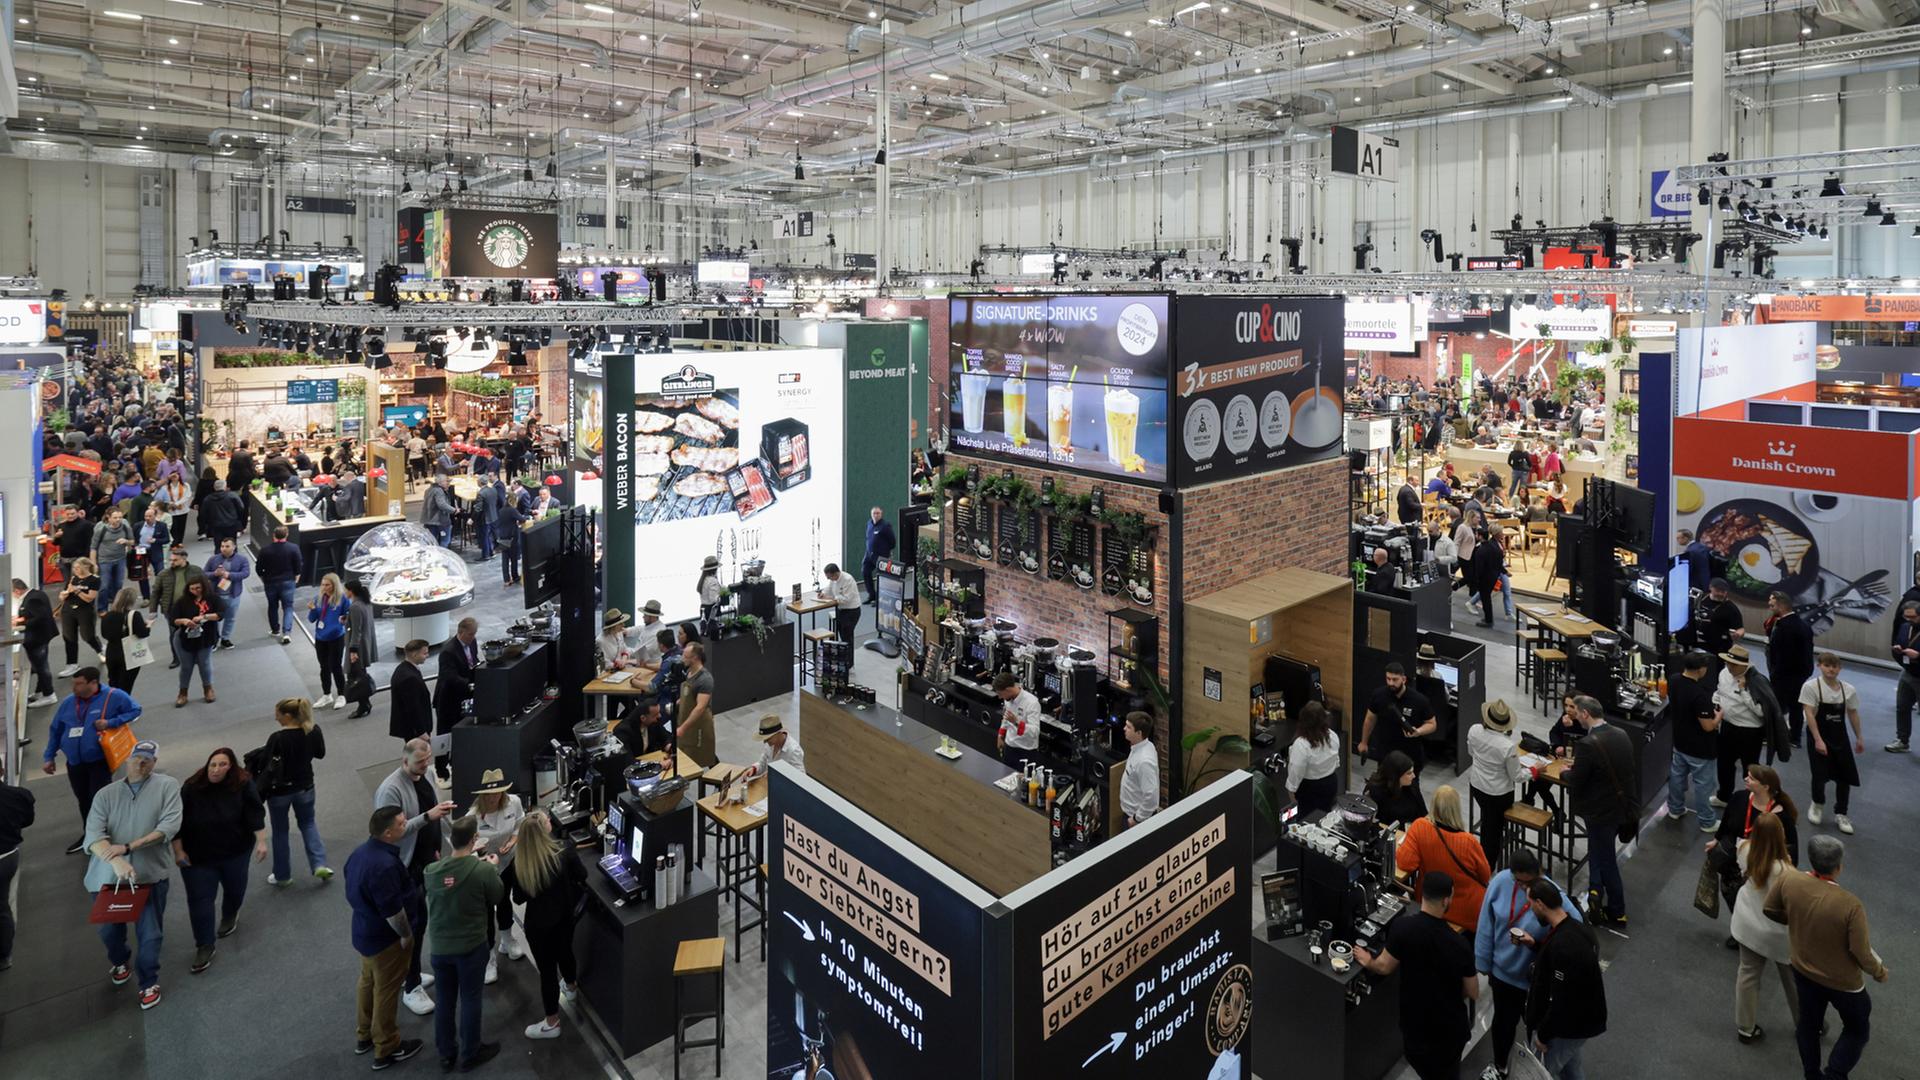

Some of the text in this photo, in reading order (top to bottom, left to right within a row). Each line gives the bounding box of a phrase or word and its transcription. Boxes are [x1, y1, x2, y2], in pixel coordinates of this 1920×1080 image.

[1361, 143, 1382, 176] A1
[287, 200, 303, 210] A2
[477, 219, 534, 242] WE PROUDLY SERVE
[577, 217, 590, 226] A2
[782, 219, 796, 237] A1
[975, 305, 1098, 321] SIGNATURE-DRINKS
[1776, 299, 1822, 312] PANOBAKE
[1235, 303, 1301, 343] CUP&CINO
[1344, 319, 1397, 329] emoortele
[1034, 327, 1066, 345] WOW
[1123, 326, 1146, 346] 2024
[849, 368, 884, 380] BEYOND
[884, 367, 907, 378] MEAT
[1110, 367, 1134, 376] GOLDEN
[1181, 355, 1300, 398] 3x BEST NEW PRODUCT
[663, 380, 713, 390] GIERLINGER
[777, 387, 812, 398] SYNERGY
[617, 412, 629, 510] WEBER BACON
[985, 440, 1001, 451] Live
[1052, 450, 1075, 463] 13:15
[1731, 456, 1836, 477] Danish Crown
[785, 818, 914, 921] Hast du Angst
[1044, 825, 1220, 960] Hör auf zu glauben
[786, 860, 948, 983] vor Siebträgern?
[1046, 870, 1202, 994] du brauchst eine
[1047, 878, 1232, 1035] gute Kaffeemaschine
[1135, 928, 1221, 1002] Du brauchst
[820, 920, 924, 1021] In 10 Minuten
[820, 952, 924, 1052] symptomfrei!
[1134, 951, 1234, 1031] einen Umsatz-
[1135, 1000, 1196, 1061] bringer!
